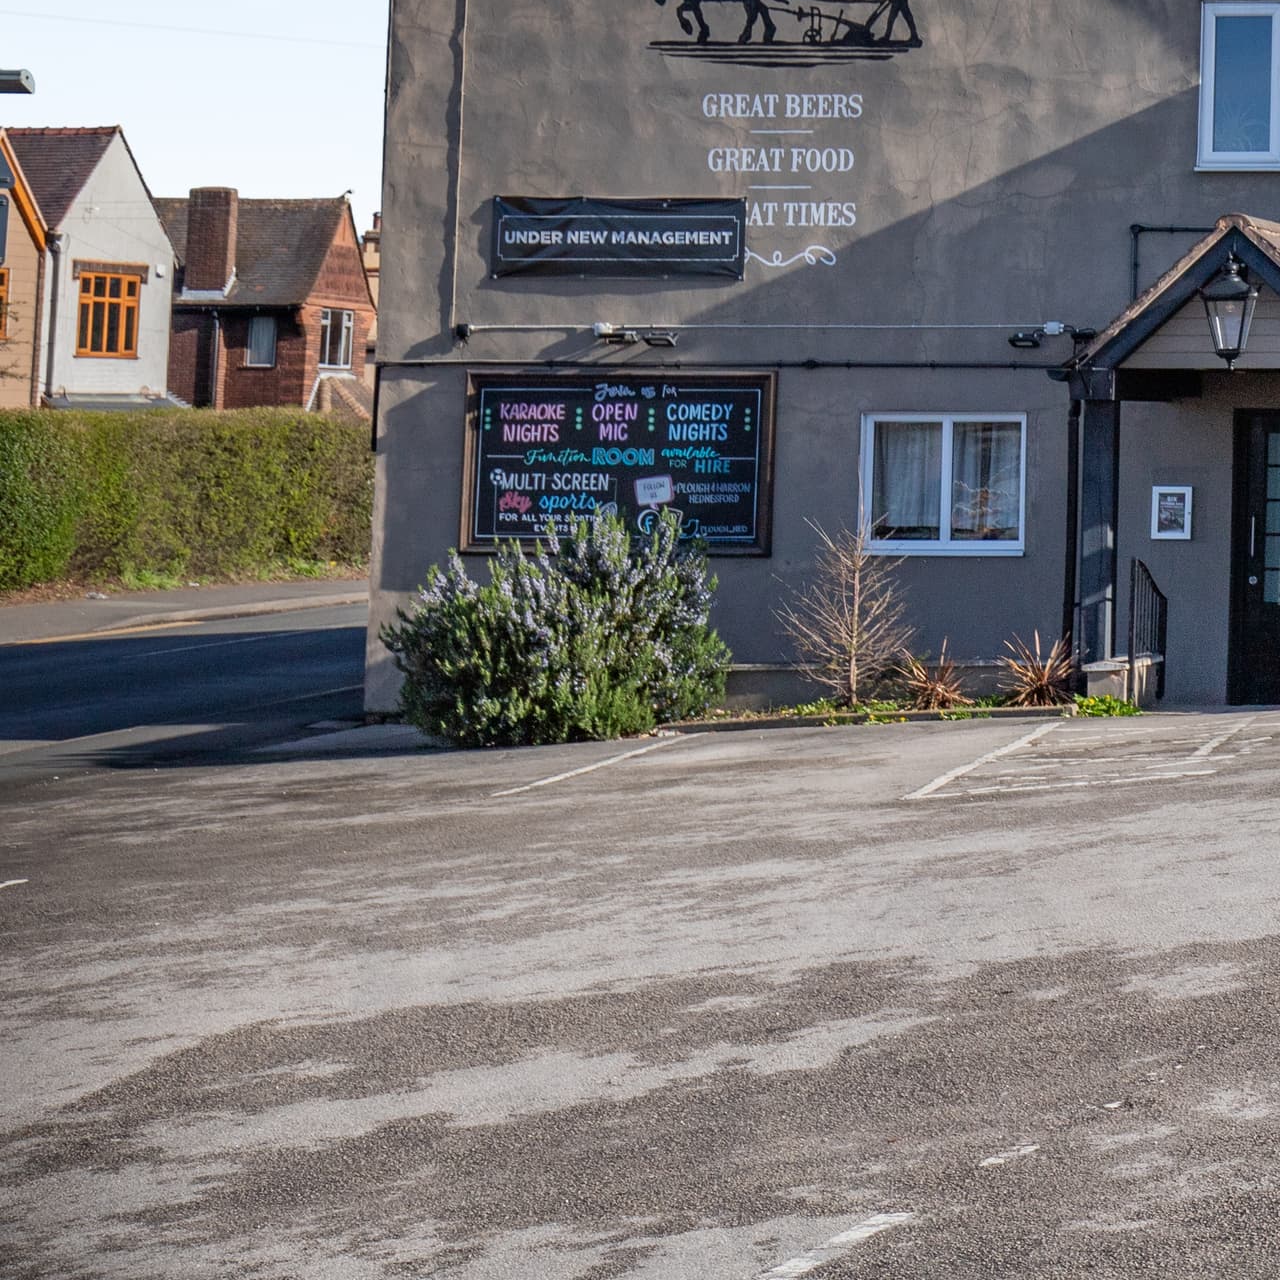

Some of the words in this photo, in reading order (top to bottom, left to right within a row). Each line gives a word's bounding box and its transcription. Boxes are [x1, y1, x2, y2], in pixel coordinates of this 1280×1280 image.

[702, 93, 779, 118] GREAT
[785, 94, 864, 118] BEERS
[707, 148, 785, 172] GREAT
[790, 148, 855, 172] FOOD
[783, 202, 857, 227] TIMES
[504, 230, 563, 245] UNDER
[567, 230, 608, 245] NEW
[611, 230, 733, 245] MANAGEMENT
[500, 402, 566, 420] KARAOKE
[592, 402, 638, 422] OPEN
[666, 403, 734, 421] COMEDY
[503, 423, 560, 442] NIGHTS
[599, 423, 629, 441] MIC
[668, 423, 728, 442] NIGHTS
[523, 447, 592, 466] Function
[592, 447, 655, 466] ROOM
[661, 446, 720, 459] available
[669, 459, 687, 468] FOR
[694, 459, 731, 473] HIRE
[502, 473, 546, 490] MULTI
[551, 473, 609, 491] SCREEN
[539, 492, 597, 513] sports
[499, 513, 519, 522] FOR
[521, 513, 537, 522] ALL
[539, 513, 562, 522] YOUR
